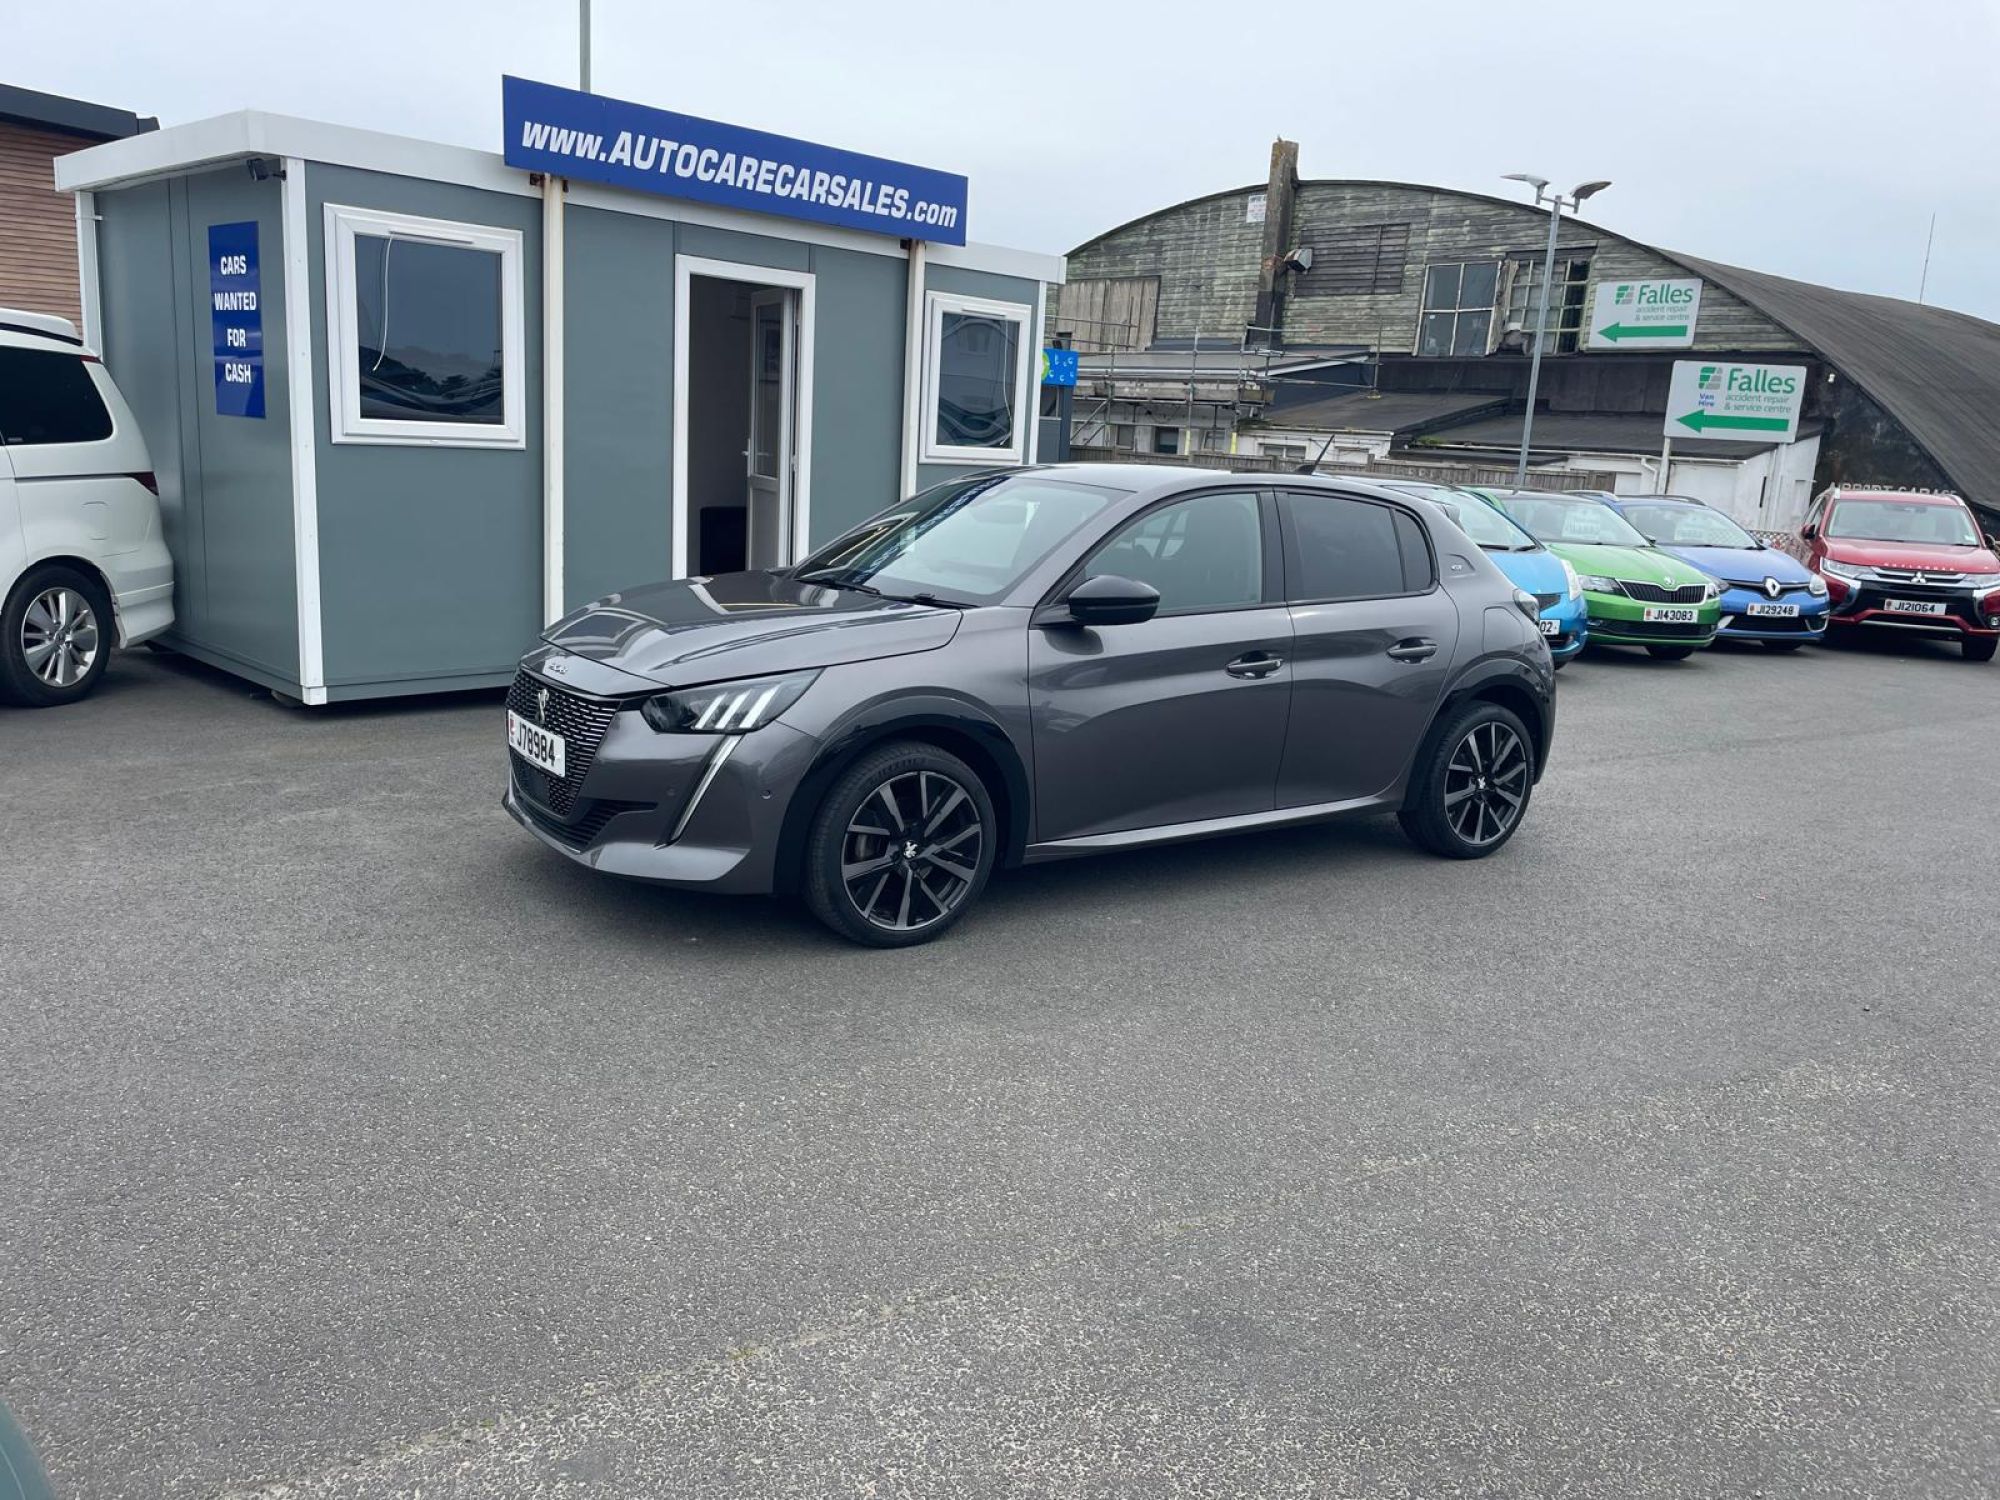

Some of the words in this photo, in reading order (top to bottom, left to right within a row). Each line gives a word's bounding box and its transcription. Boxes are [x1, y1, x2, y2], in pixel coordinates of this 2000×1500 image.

[521, 120, 957, 228] www.AUTOCARECARSALES.com
[220, 255, 247, 275] CARS
[214, 291, 257, 311] WANTED
[1637, 283, 1694, 304] Falles
[1635, 305, 1665, 313] accident
[227, 328, 247, 347] FOR
[225, 363, 252, 383] CASH
[1726, 367, 1796, 395] Falles
[1725, 393, 1761, 402] accident
[1763, 396, 1790, 405] repair
[1764, 405, 1792, 413] centre
[1654, 609, 1693, 621] J143083
[517, 721, 556, 767] J78984
